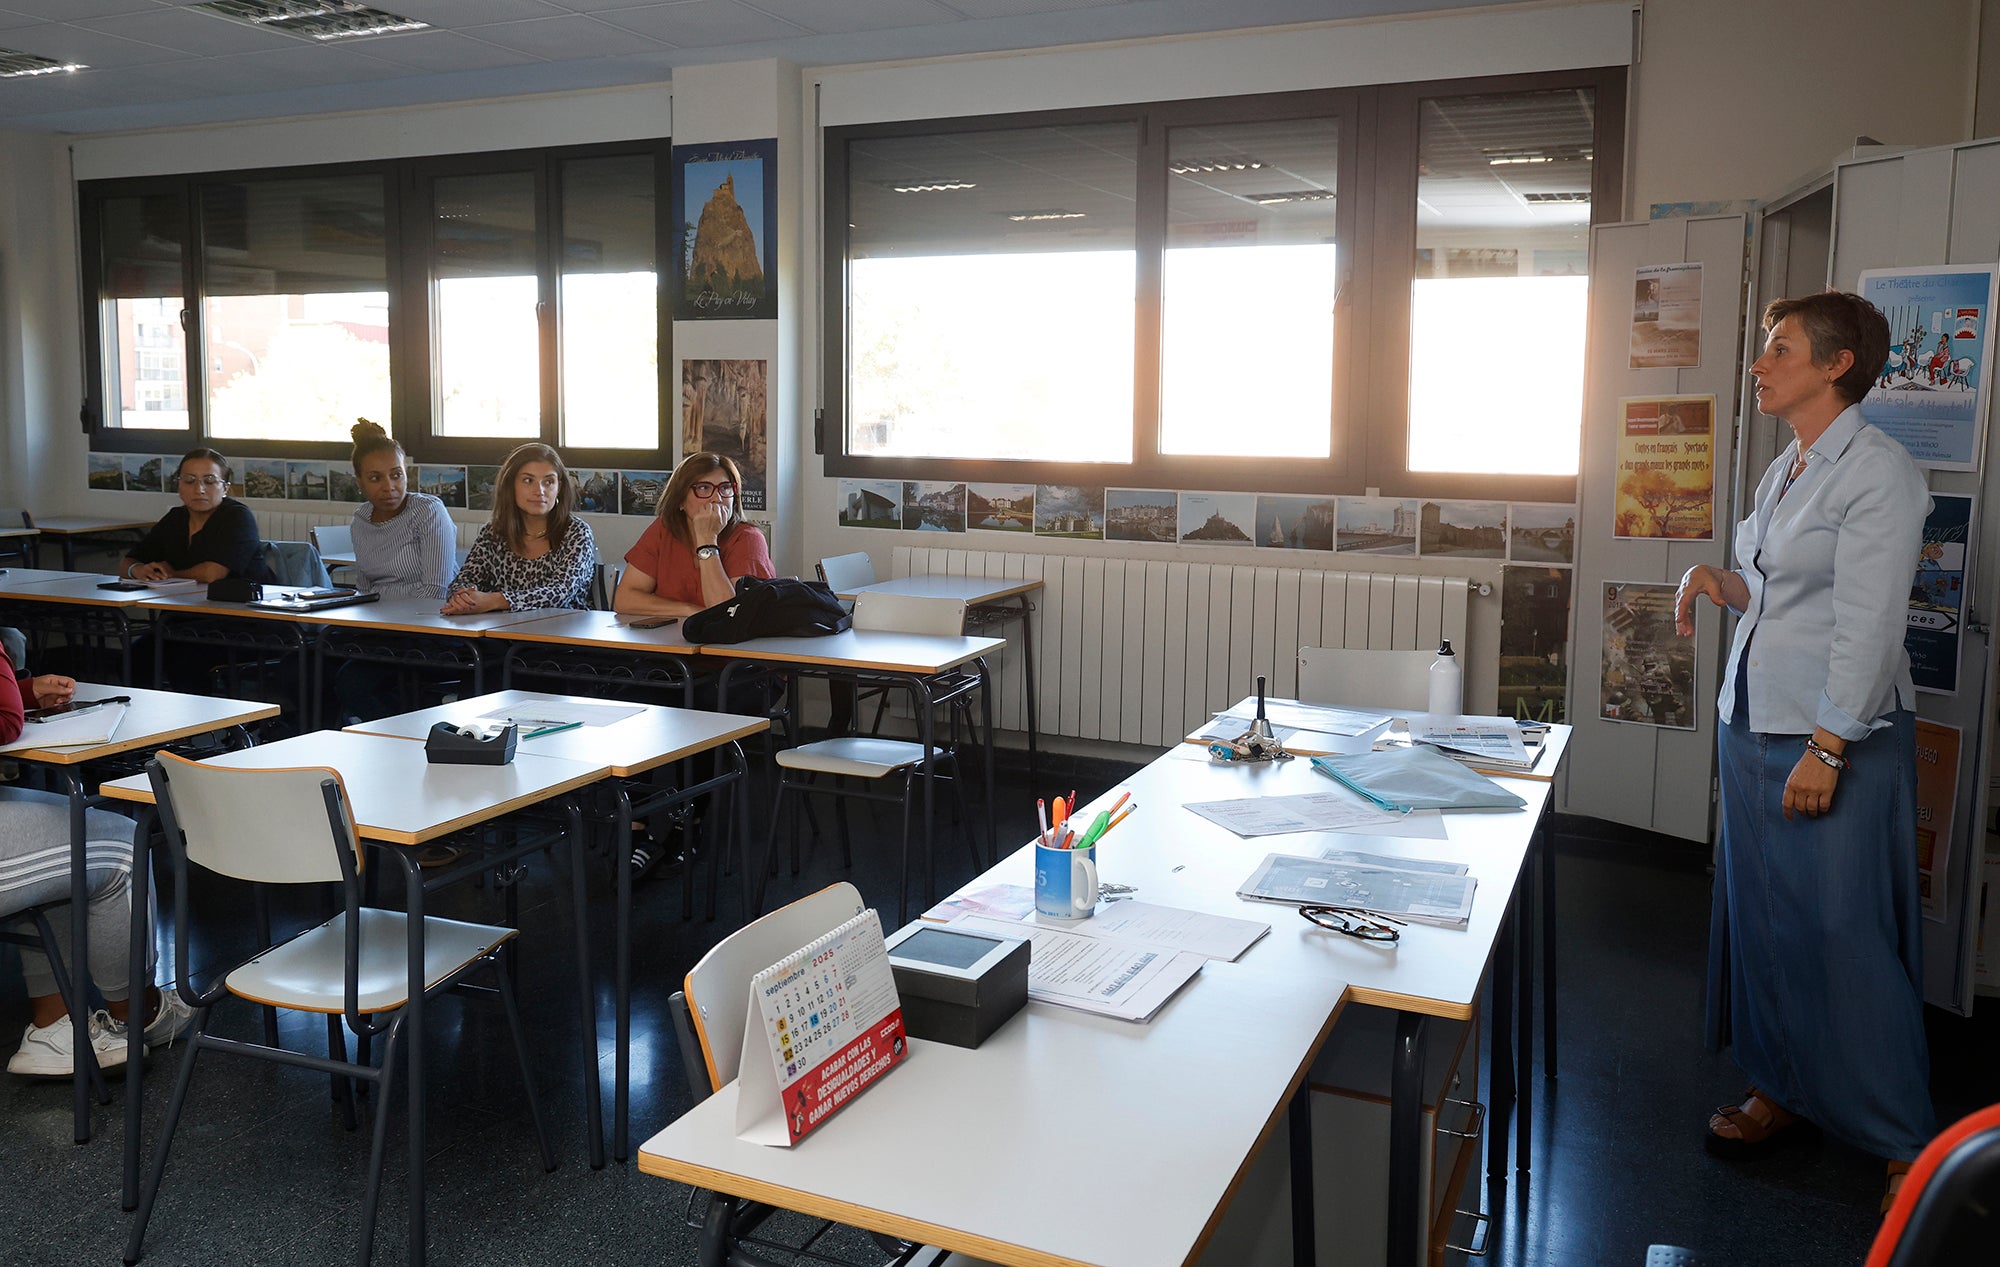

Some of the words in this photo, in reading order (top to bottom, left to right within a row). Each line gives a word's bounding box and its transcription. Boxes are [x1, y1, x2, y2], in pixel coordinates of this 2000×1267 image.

[1876, 280, 1886, 290] Le
[1888, 278, 1920, 289] Théâtre
[1922, 278, 1934, 288] du
[1608, 586, 1617, 600] 9
[766, 968, 806, 997] septiembre
[812, 948, 834, 968] 2025
[776, 1006, 780, 1014] 1
[785, 998, 791, 1008] 2
[795, 992, 800, 1002] 3
[805, 986, 810, 995] 4
[814, 980, 820, 990] 5
[824, 974, 829, 984] 6
[832, 968, 836, 978] 7
[780, 1018, 784, 1030] 8
[788, 1014, 794, 1023] 9
[798, 1006, 806, 1017] 10
[808, 1001, 814, 1010] 11
[816, 994, 824, 1004] 12
[826, 988, 834, 998] 13
[835, 982, 842, 992] 14
[781, 1034, 790, 1046] 15
[791, 1027, 799, 1038] 16
[801, 1020, 808, 1032] 17
[810, 1014, 818, 1027] 18
[820, 1008, 828, 1019] 19
[828, 1002, 837, 1014] 20
[838, 996, 846, 1006] 21
[783, 1048, 794, 1062] 22
[794, 1042, 802, 1054] 23
[804, 1036, 812, 1047] 24
[813, 1029, 822, 1040] 25
[822, 1022, 832, 1034] 26
[832, 1016, 840, 1028] 27
[841, 1010, 849, 1022] 28
[821, 1054, 846, 1081] ACABAR
[846, 1044, 860, 1062] CON
[860, 1036, 872, 1052] LAS
[786, 1062, 797, 1077] 29
[798, 1056, 806, 1069] 30
[808, 1098, 833, 1124] GANAR
[833, 1078, 859, 1106] NUEVOS
[860, 1052, 892, 1086] DERECHOS
[816, 1052, 871, 1102] DESIGUALDADES
[870, 1047, 876, 1060] Y
